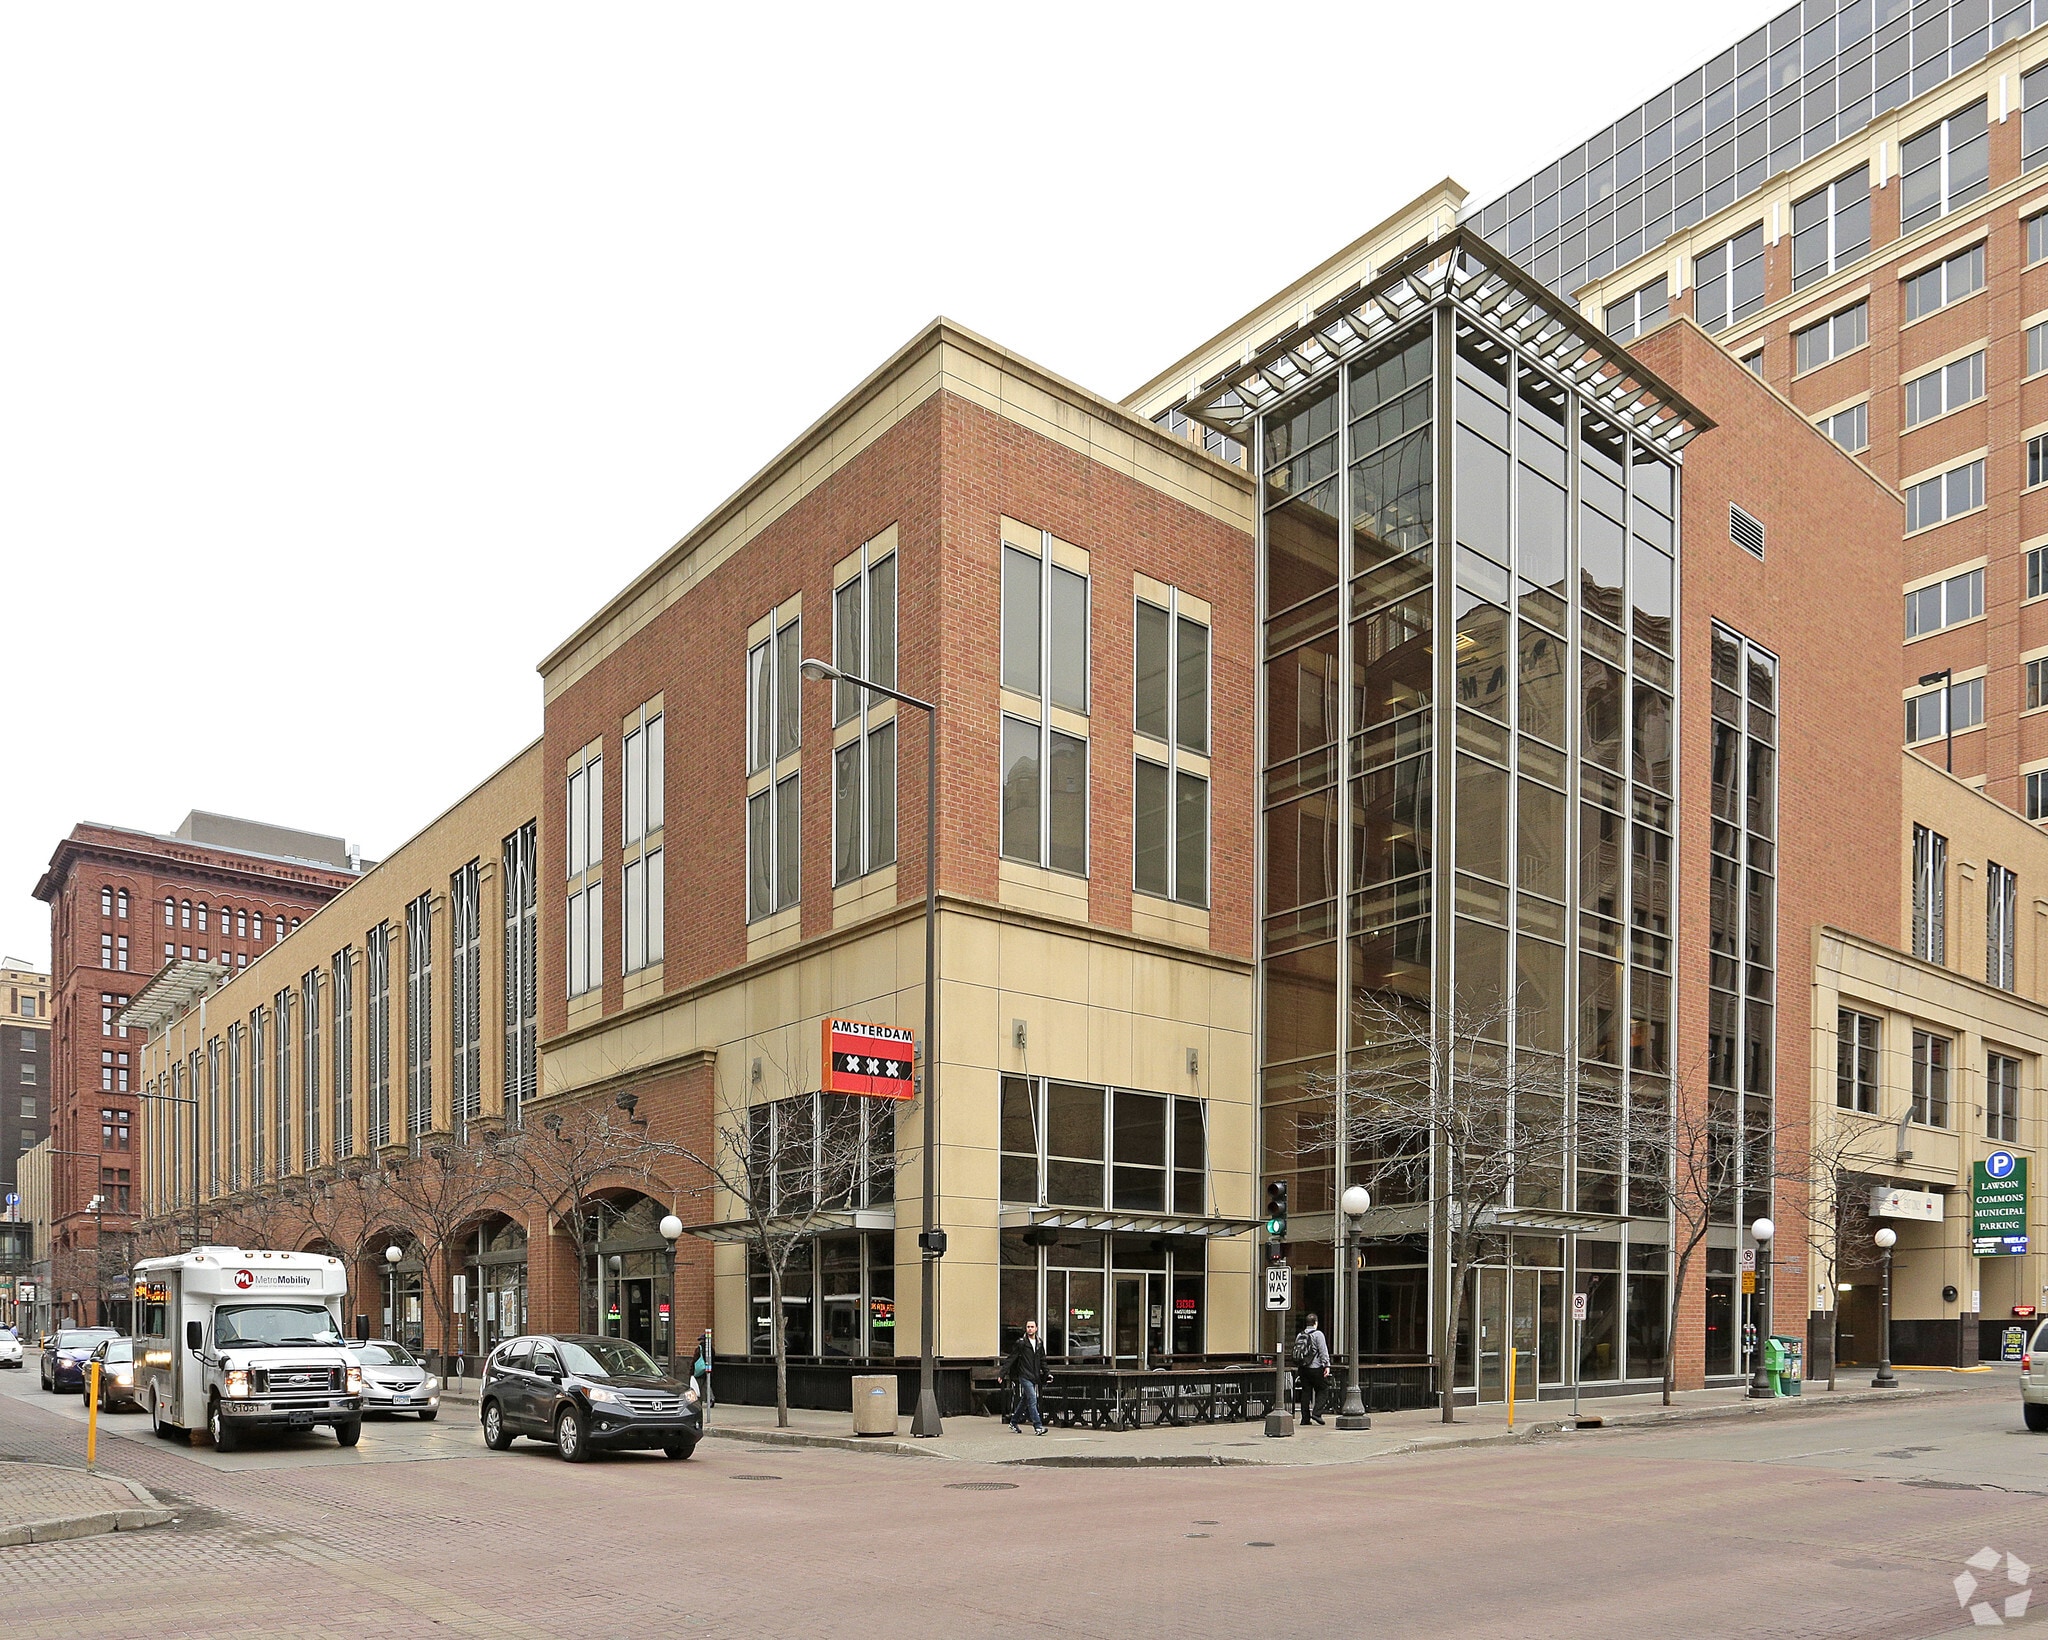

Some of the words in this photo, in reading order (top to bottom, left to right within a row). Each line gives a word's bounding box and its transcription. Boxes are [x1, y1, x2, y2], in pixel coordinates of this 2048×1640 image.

[832, 1020, 912, 1041] AMSTERDAM
[1993, 1155, 2008, 1173] P
[1981, 1181, 2019, 1190] LAWSON
[1976, 1194, 2024, 1204] COMMONS
[1974, 1208, 2025, 1217] MUNICIPAL
[1979, 1222, 2020, 1231] PARKING
[255, 1275, 311, 1286] MetroMobility
[1269, 1271, 1287, 1281] ONE
[1268, 1282, 1288, 1293] WAY
[872, 1318, 896, 1328] Heineken
[232, 1404, 259, 1413] 61031
